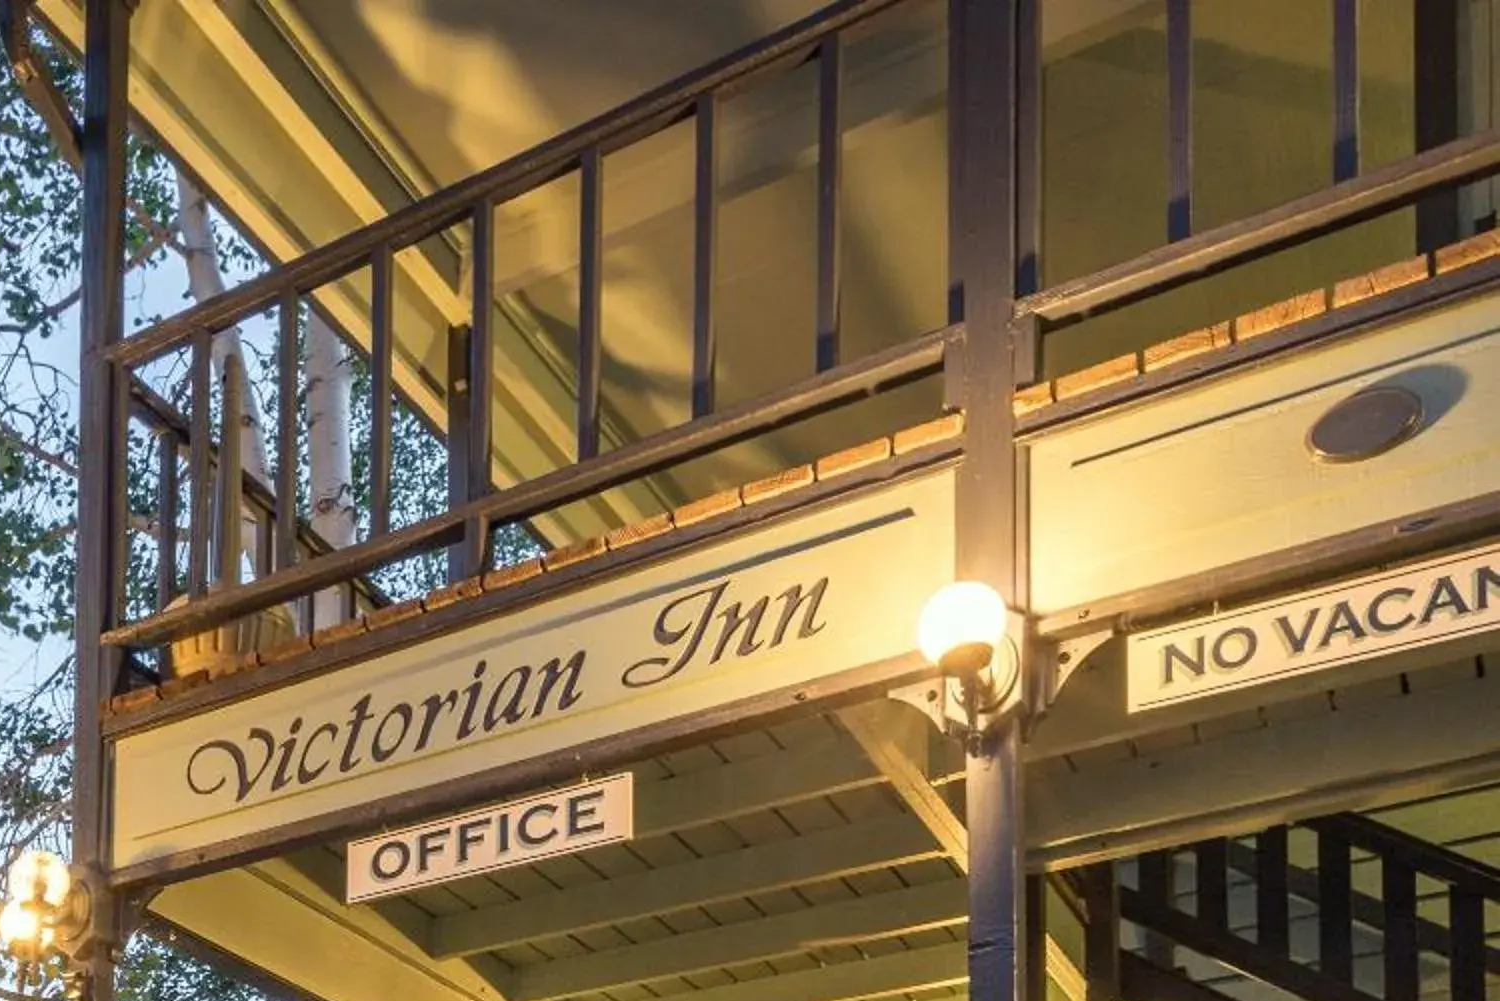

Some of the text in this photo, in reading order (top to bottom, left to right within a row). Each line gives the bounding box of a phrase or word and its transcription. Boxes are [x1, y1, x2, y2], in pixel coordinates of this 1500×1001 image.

[186, 575, 830, 801] Victorian Inn
[1162, 626, 1259, 685] NO
[370, 789, 606, 882] OFFICE
